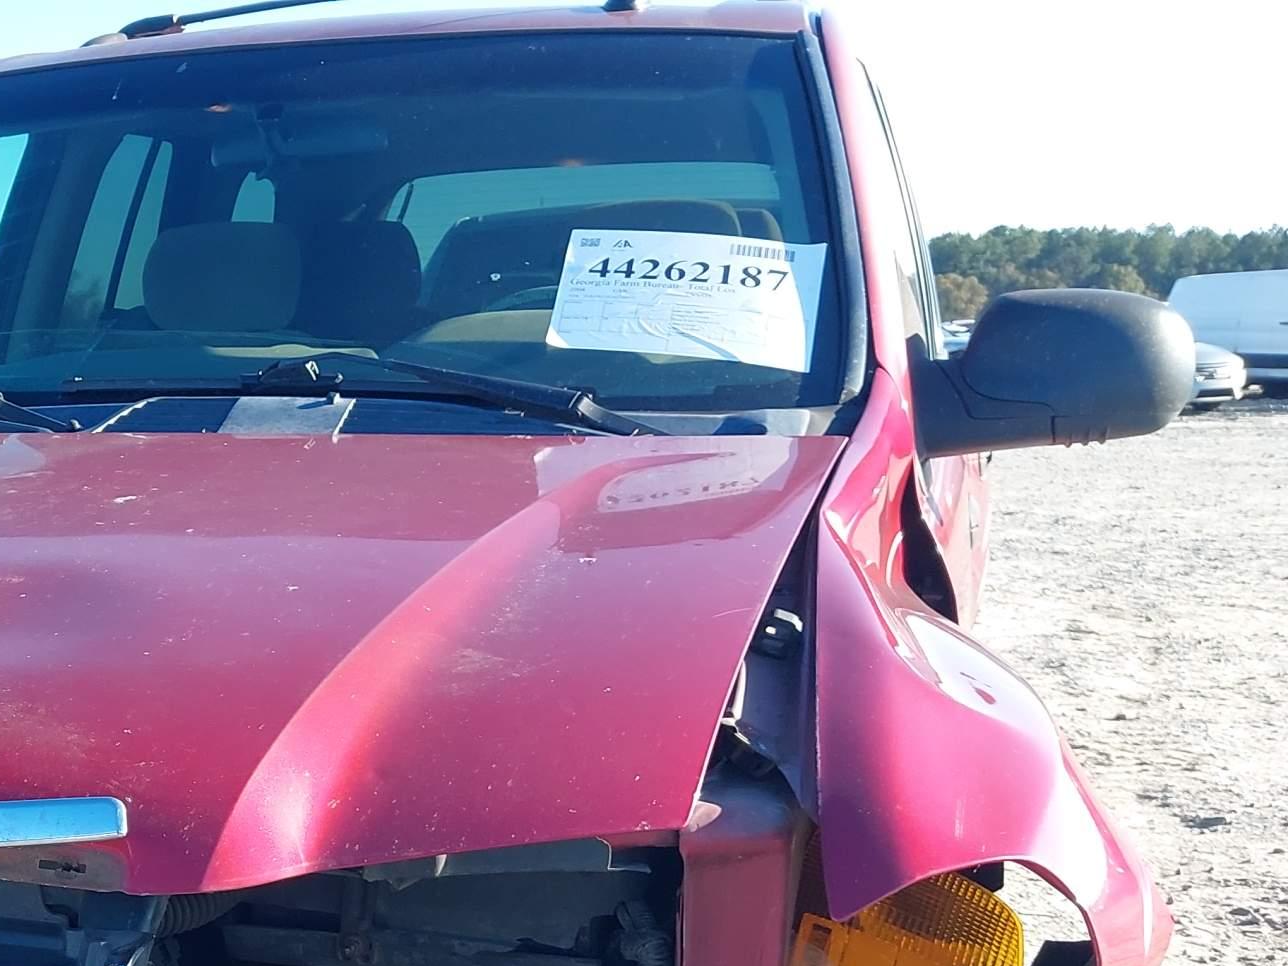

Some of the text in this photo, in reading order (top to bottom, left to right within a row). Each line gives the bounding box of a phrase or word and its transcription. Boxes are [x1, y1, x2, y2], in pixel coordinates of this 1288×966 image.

[570, 278, 610, 287] Georgia
[614, 279, 640, 287] Farm
[688, 284, 713, 292] Total
[589, 257, 789, 291] 44262187
